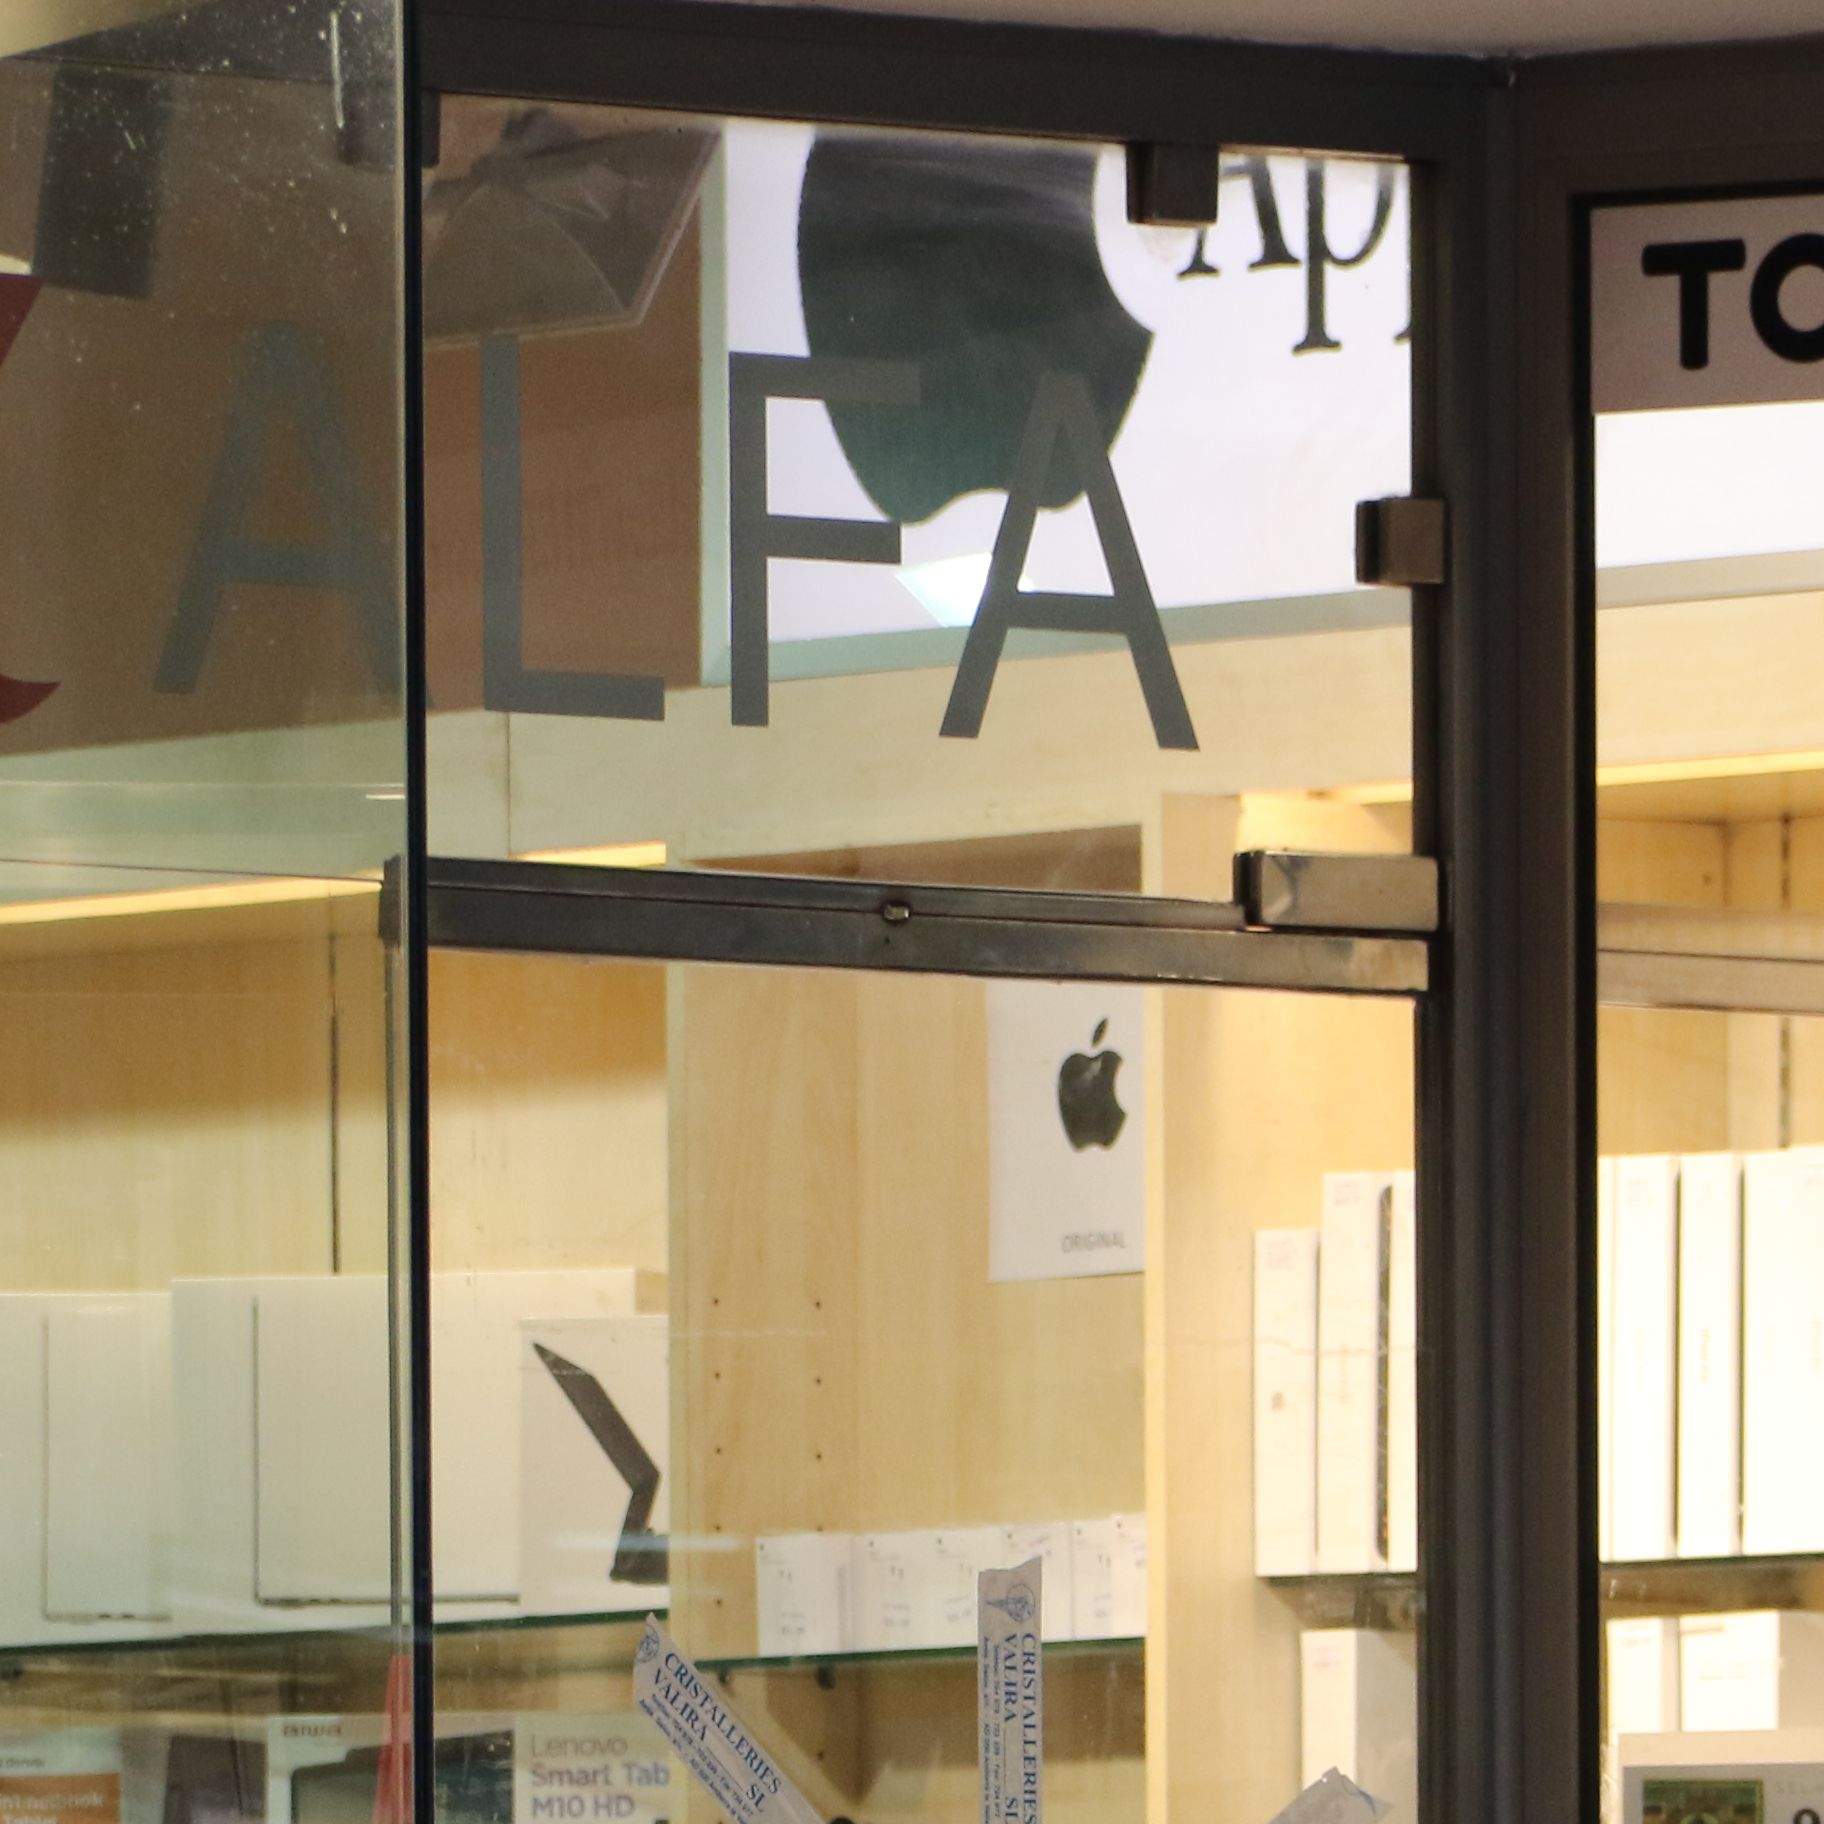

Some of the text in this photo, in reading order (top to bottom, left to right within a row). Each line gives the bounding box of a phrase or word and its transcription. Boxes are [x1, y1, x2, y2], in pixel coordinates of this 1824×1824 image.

[152, 318, 1200, 751] ALFA
[647, 1667, 713, 1743] VALIRA
[1003, 1633, 1018, 1722] VALIRA
[532, 1735, 628, 1758] Lenovo
[661, 1649, 785, 1795] CRISTALLERIES
[1022, 1633, 1036, 1824] CRISTALLERIES
[532, 1762, 670, 1786] Smart Tab
[532, 1796, 636, 1819] M10 HD
